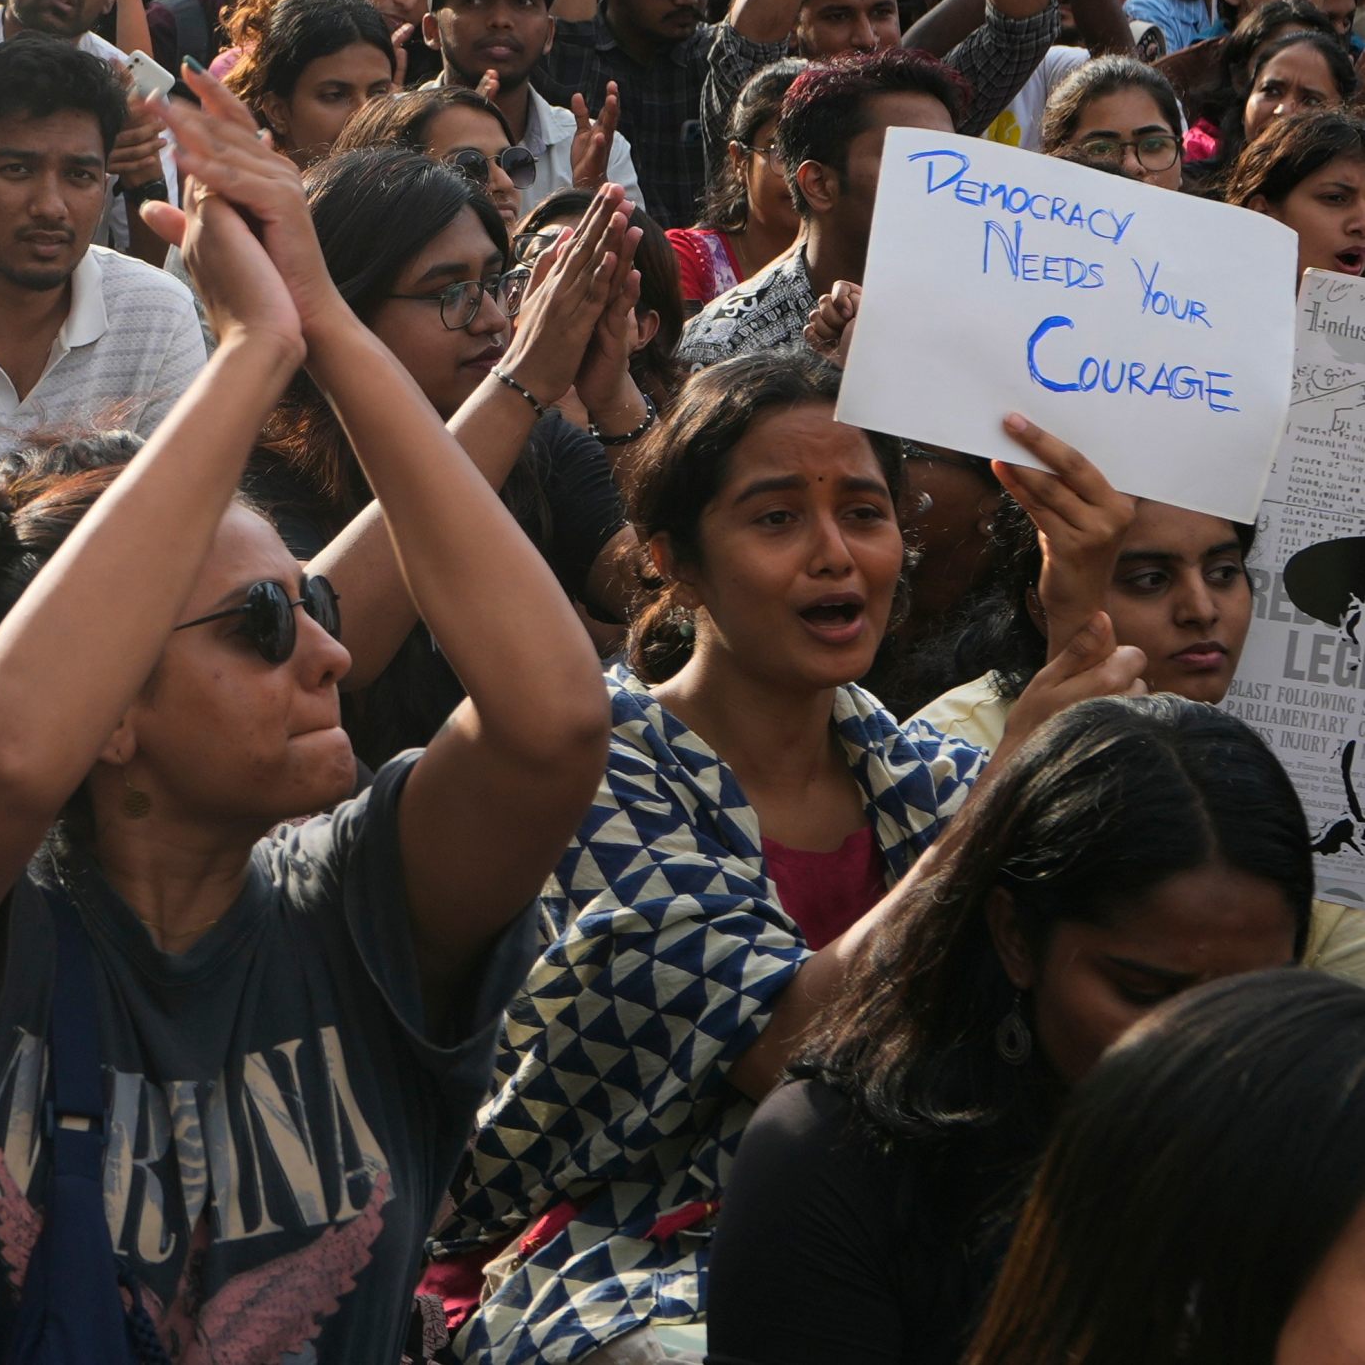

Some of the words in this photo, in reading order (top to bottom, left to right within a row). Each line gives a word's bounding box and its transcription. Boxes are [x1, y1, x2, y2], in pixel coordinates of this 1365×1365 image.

[907, 149, 1135, 244] DEMOCRACY
[981, 220, 1104, 289] NEEDS
[1132, 257, 1213, 328] YOUR
[1026, 315, 1241, 412] COURAGE
[1226, 700, 1349, 734] PARLIAMENTARY
[1228, 680, 1271, 701] BLAST
[1278, 686, 1356, 714] FOLLOWING
[1280, 731, 1329, 753] INJURY
